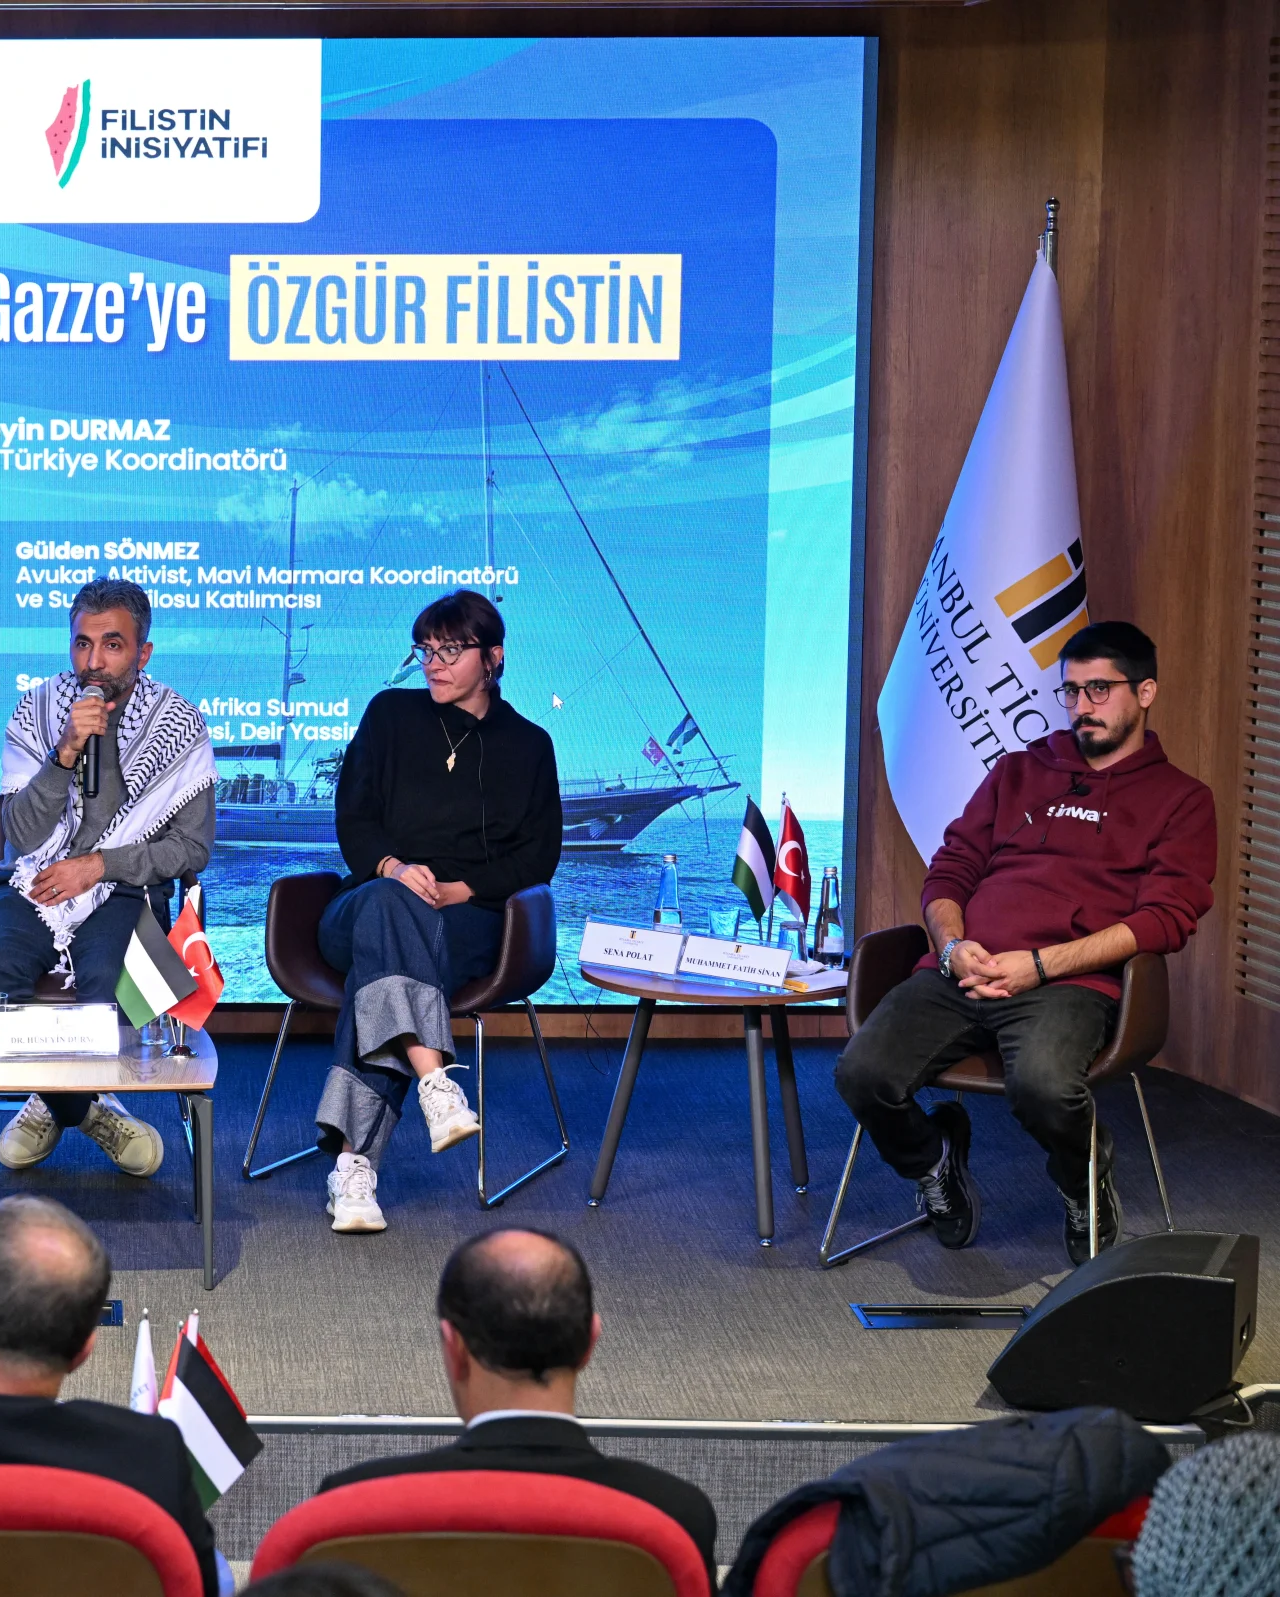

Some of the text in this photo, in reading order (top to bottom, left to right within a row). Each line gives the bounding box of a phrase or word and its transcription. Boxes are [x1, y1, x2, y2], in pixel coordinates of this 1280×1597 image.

[247, 261, 427, 345] ÖZGÜR
[446, 260, 663, 345] FİLİSTİN
[50, 419, 171, 441] DURMAZ
[105, 447, 287, 471] Koordinatörü
[15, 537, 200, 560] Gülden SÖNMEZ
[108, 564, 192, 587] Aktivist,
[197, 565, 251, 584] Mavi
[257, 566, 364, 585] Marmara
[370, 565, 519, 585] Koordinatörü
[16, 593, 44, 609] ve
[206, 589, 321, 609] Katılımcısı
[931, 524, 992, 665] ANBUL
[915, 577, 1010, 773] ÜNİVERSİTE
[197, 697, 349, 717] Afrika Sumud
[241, 721, 285, 741] Deir
[603, 947, 654, 962] SENA POLAT
[685, 956, 732, 970] MUHAMMET
[732, 963, 757, 975] FATİH
[757, 966, 782, 978] SİNAN
